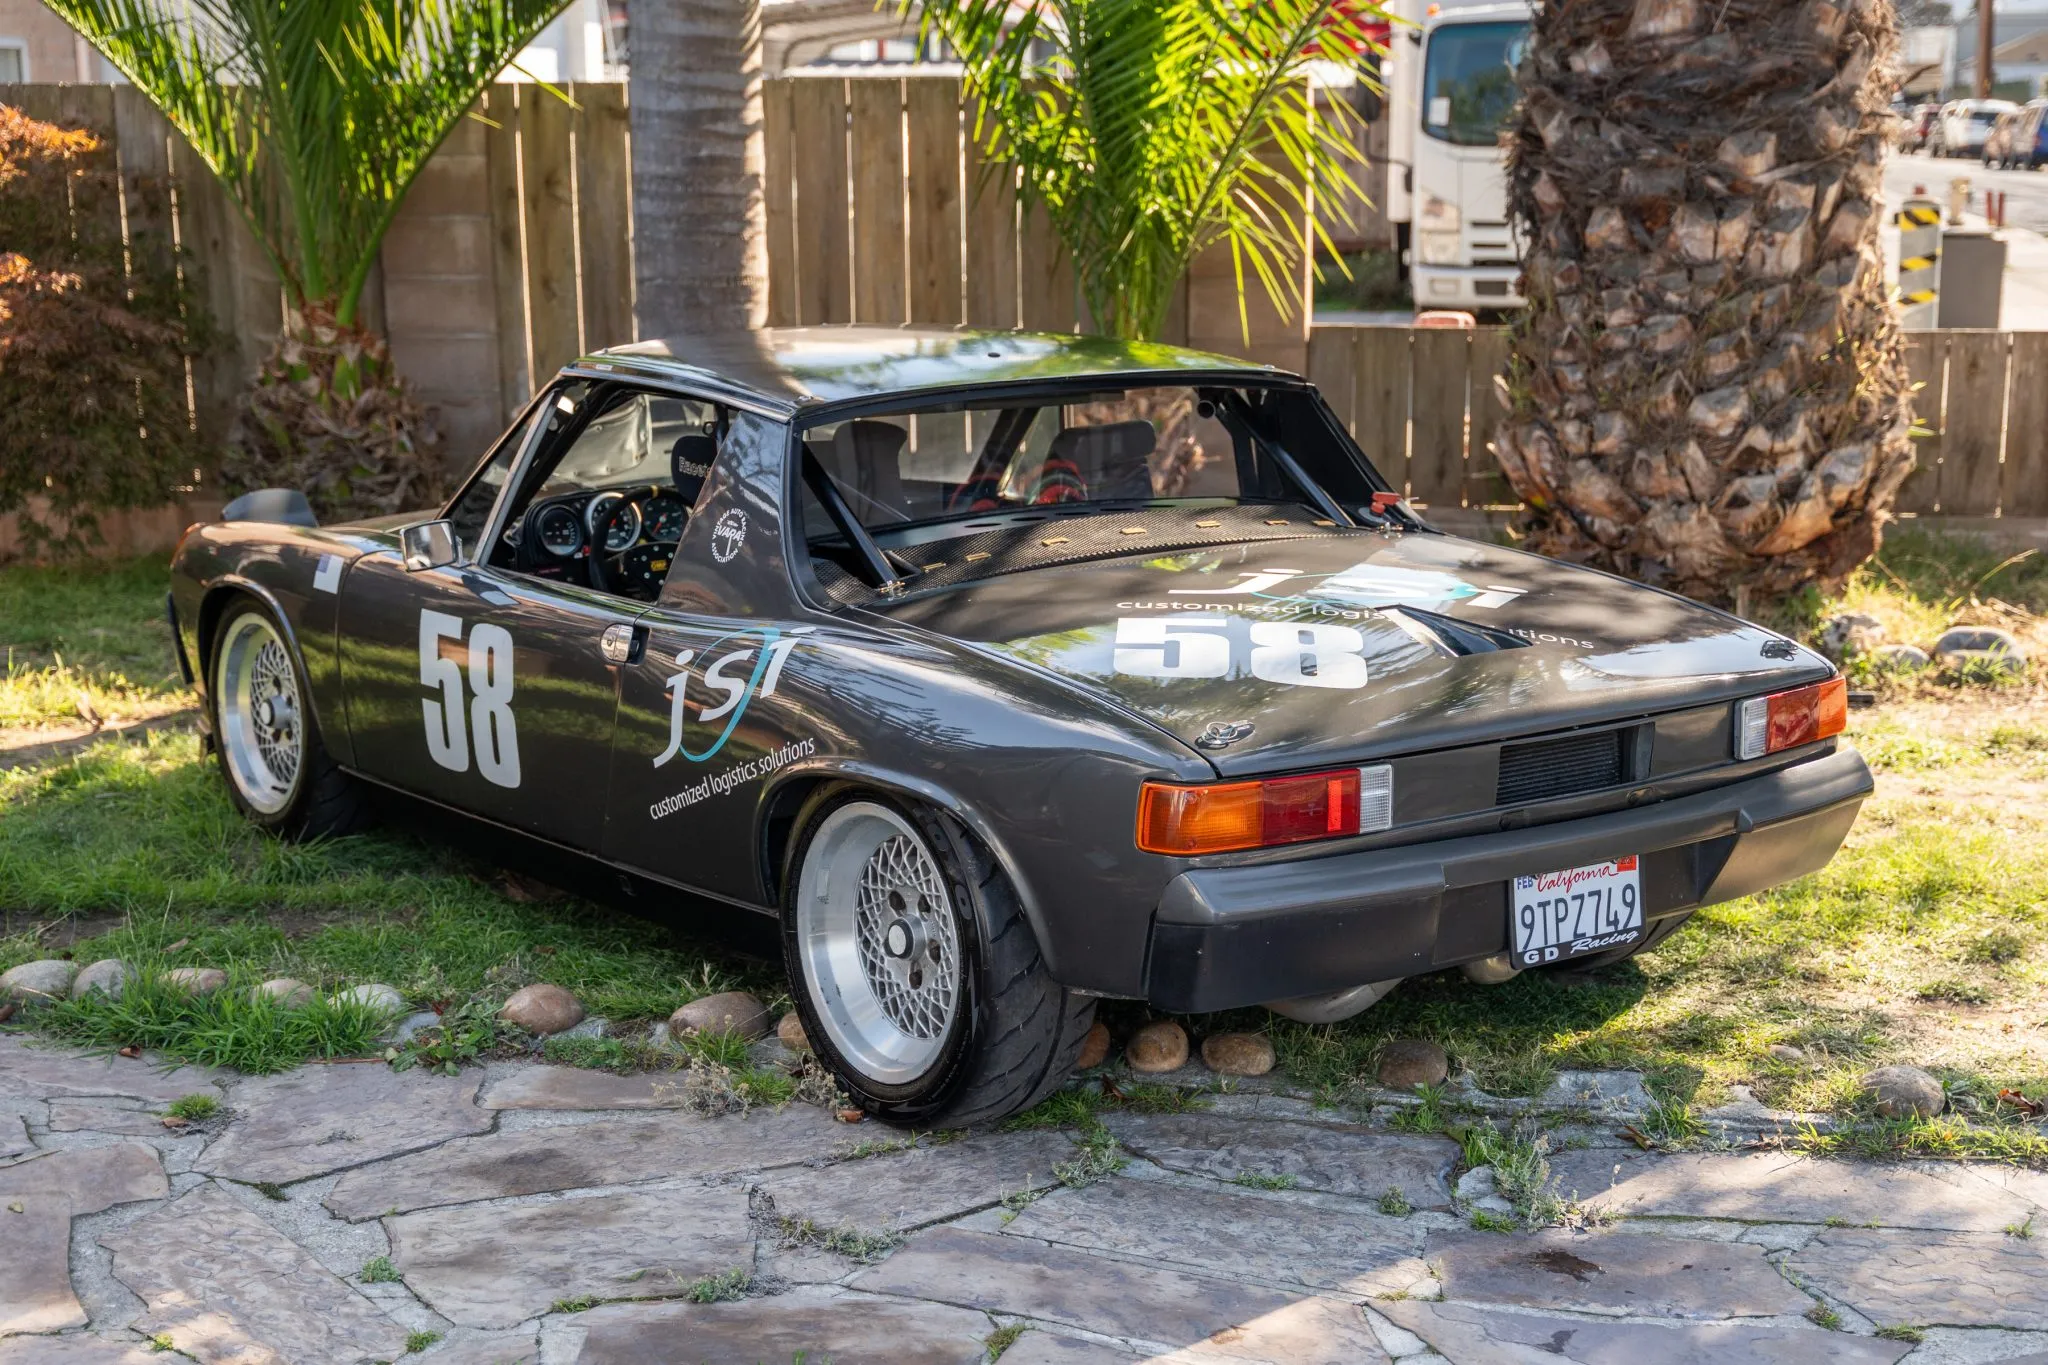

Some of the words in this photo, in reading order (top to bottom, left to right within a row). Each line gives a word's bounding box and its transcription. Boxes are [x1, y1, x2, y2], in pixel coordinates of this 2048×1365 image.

[711, 542, 739, 563] ASSOCIATION
[717, 524, 743, 542] VARA
[1113, 617, 1368, 689] 58
[1116, 601, 1300, 614] customized
[1312, 605, 1387, 620] logis
[1508, 628, 1594, 649] tions
[419, 608, 522, 789] 58
[652, 626, 817, 768] jsi
[650, 776, 711, 820] customized
[709, 760, 758, 796] logistics
[758, 737, 815, 774] solutions
[1517, 876, 1534, 890] FEB
[1536, 865, 1619, 894] California
[1520, 883, 1636, 951] 9TPZ749
[1570, 929, 1640, 954] Racing
